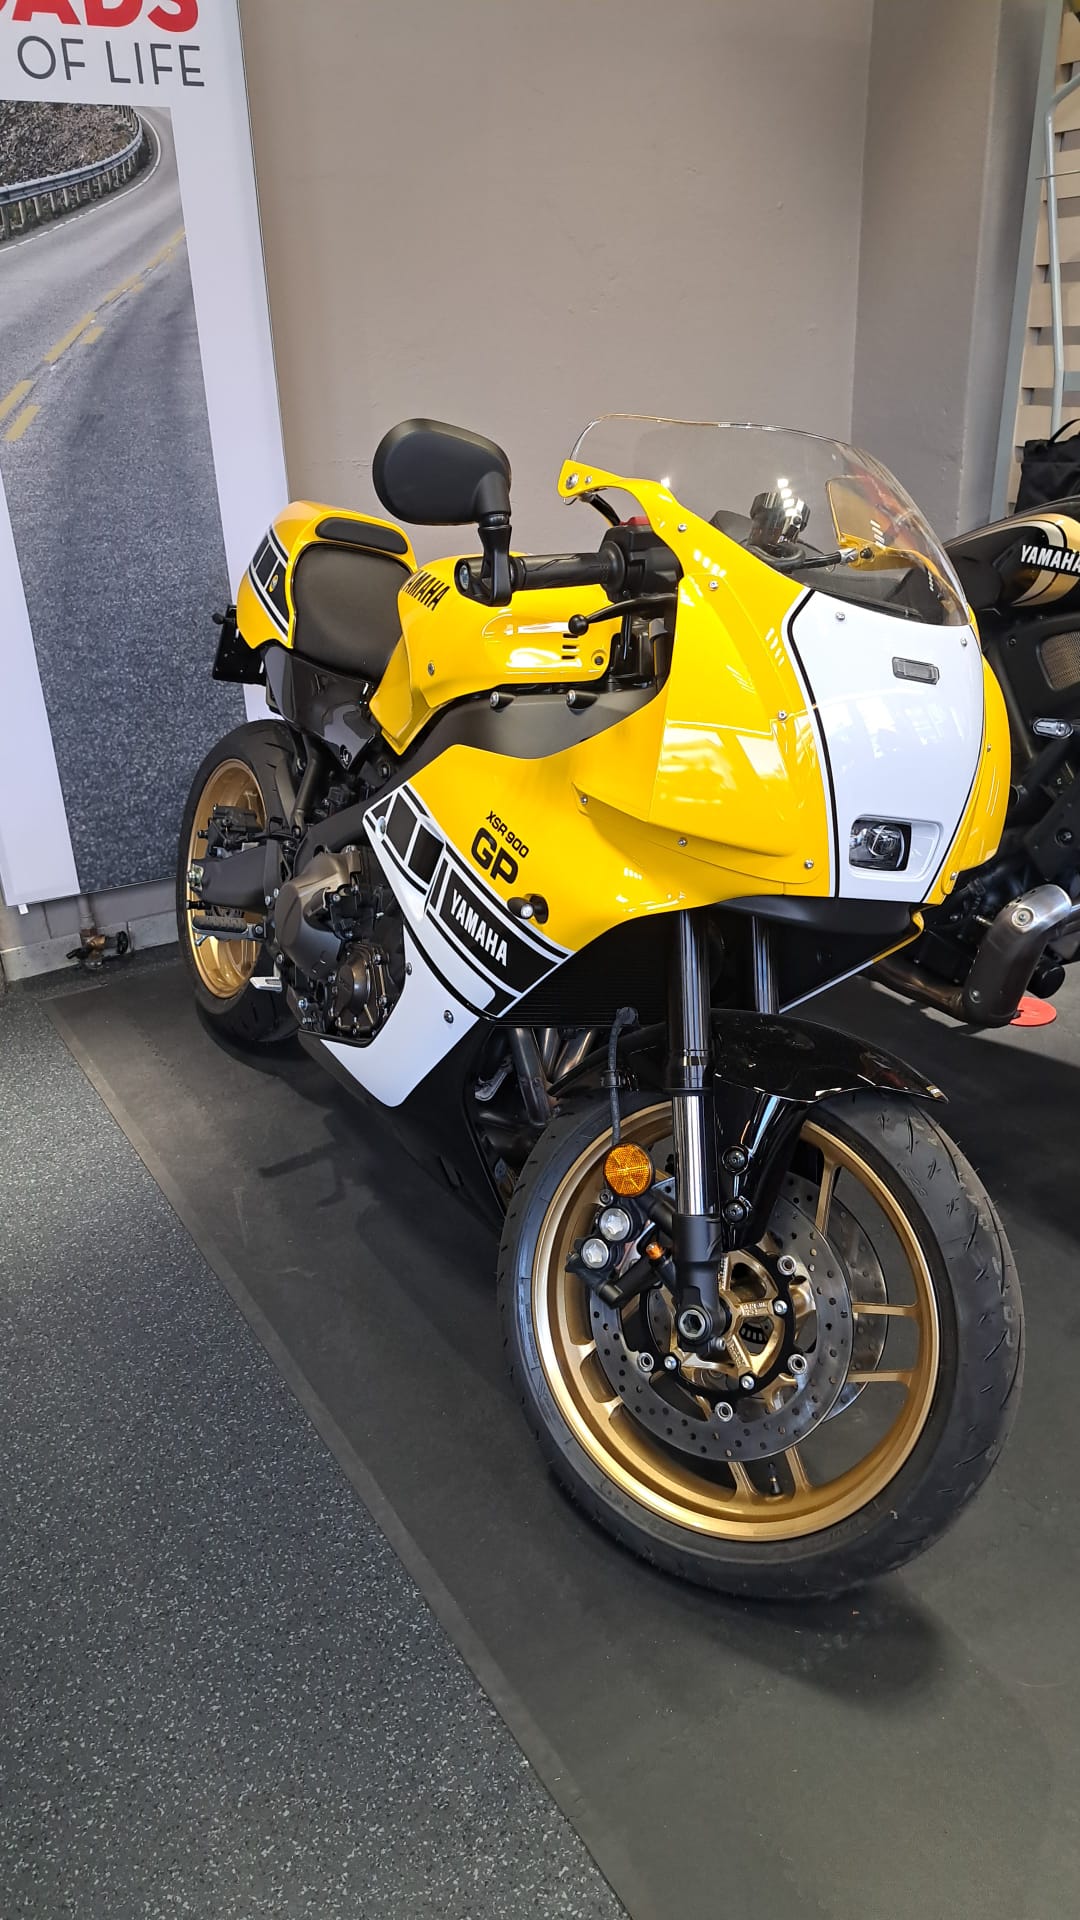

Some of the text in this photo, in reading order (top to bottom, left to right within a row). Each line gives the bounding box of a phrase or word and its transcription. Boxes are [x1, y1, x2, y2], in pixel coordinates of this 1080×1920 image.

[17, 35, 205, 87] OF LIFE
[471, 826, 519, 885] GP
[485, 810, 530, 859] XSR 900
[450, 887, 508, 968] YAMAHA
